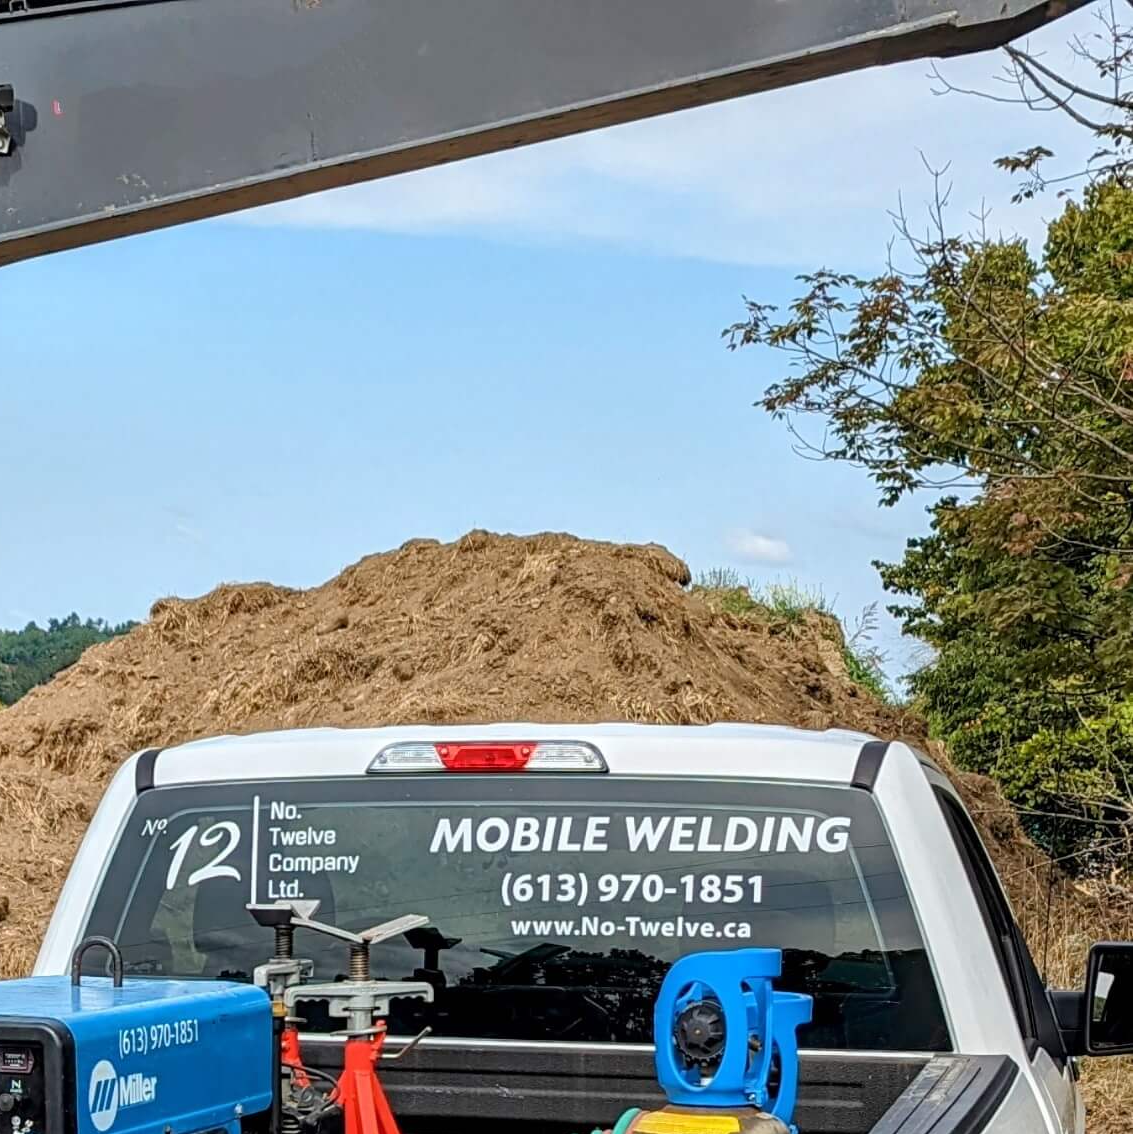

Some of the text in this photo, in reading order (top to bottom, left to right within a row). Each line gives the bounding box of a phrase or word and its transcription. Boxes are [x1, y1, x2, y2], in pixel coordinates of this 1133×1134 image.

[270, 801, 302, 820] No.
[269, 827, 336, 846] Twelve
[430, 816, 851, 853] MOBILE WELDING
[167, 821, 241, 890] 12
[269, 853, 359, 874] Company
[268, 880, 304, 898] Ltd.
[501, 872, 763, 906] (613) 970-1851
[511, 917, 751, 938] www.No-Twelve.ca
[118, 1019, 199, 1059] (613) 970-1851
[119, 1072, 157, 1107] Miller
